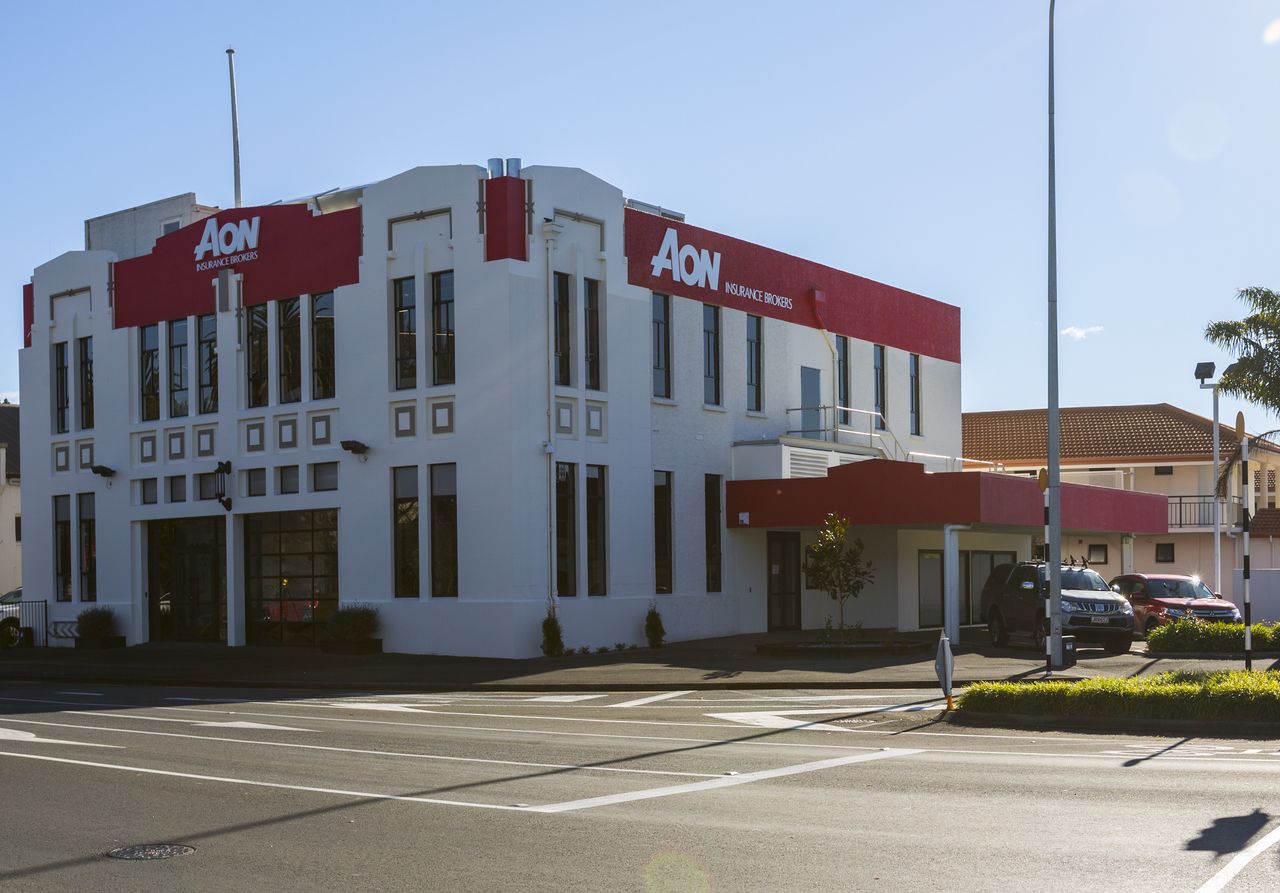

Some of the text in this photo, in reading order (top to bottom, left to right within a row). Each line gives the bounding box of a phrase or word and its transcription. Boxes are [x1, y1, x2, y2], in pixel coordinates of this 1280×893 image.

[194, 216, 260, 261] AON
[197, 251, 258, 271] INSURANCE BROKERS
[650, 227, 721, 291] AON
[725, 282, 793, 310] INSURANCE BROKERS
